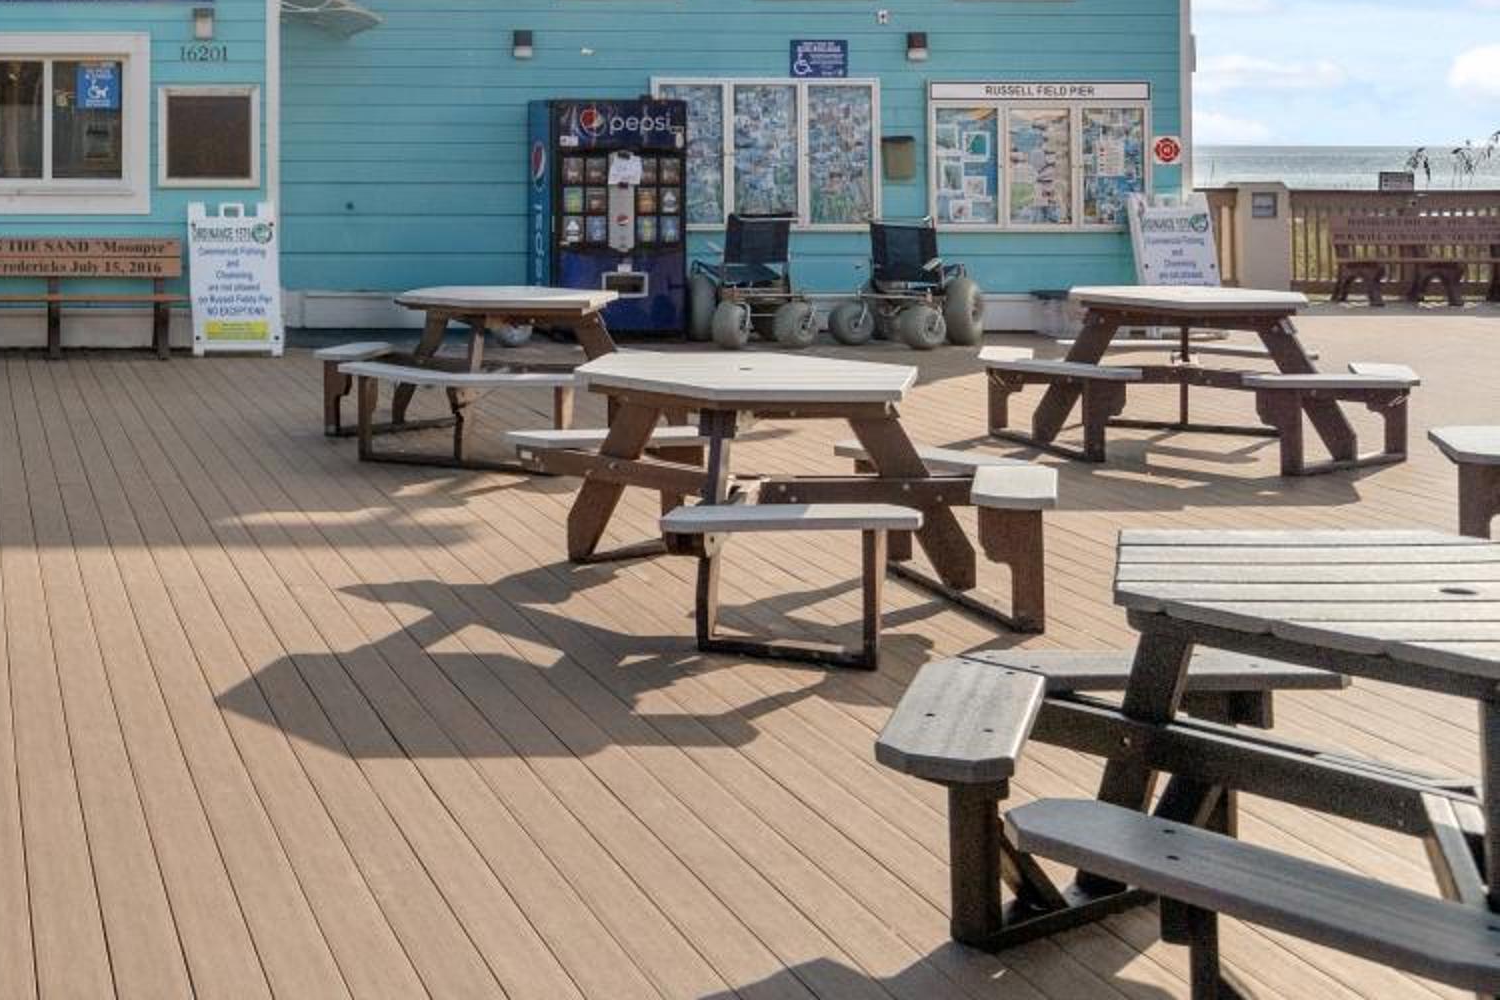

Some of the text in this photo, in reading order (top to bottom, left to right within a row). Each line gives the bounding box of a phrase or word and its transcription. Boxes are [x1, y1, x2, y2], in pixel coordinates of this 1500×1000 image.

[180, 45, 228, 62] 16201
[985, 85, 1096, 97] RUSSELL FIELD PIER
[609, 111, 671, 135] pepsi
[8, 240, 36, 252] THE
[44, 241, 89, 252] SAND
[71, 260, 98, 277] July
[105, 261, 126, 275] 15,
[129, 261, 162, 273] 2016
